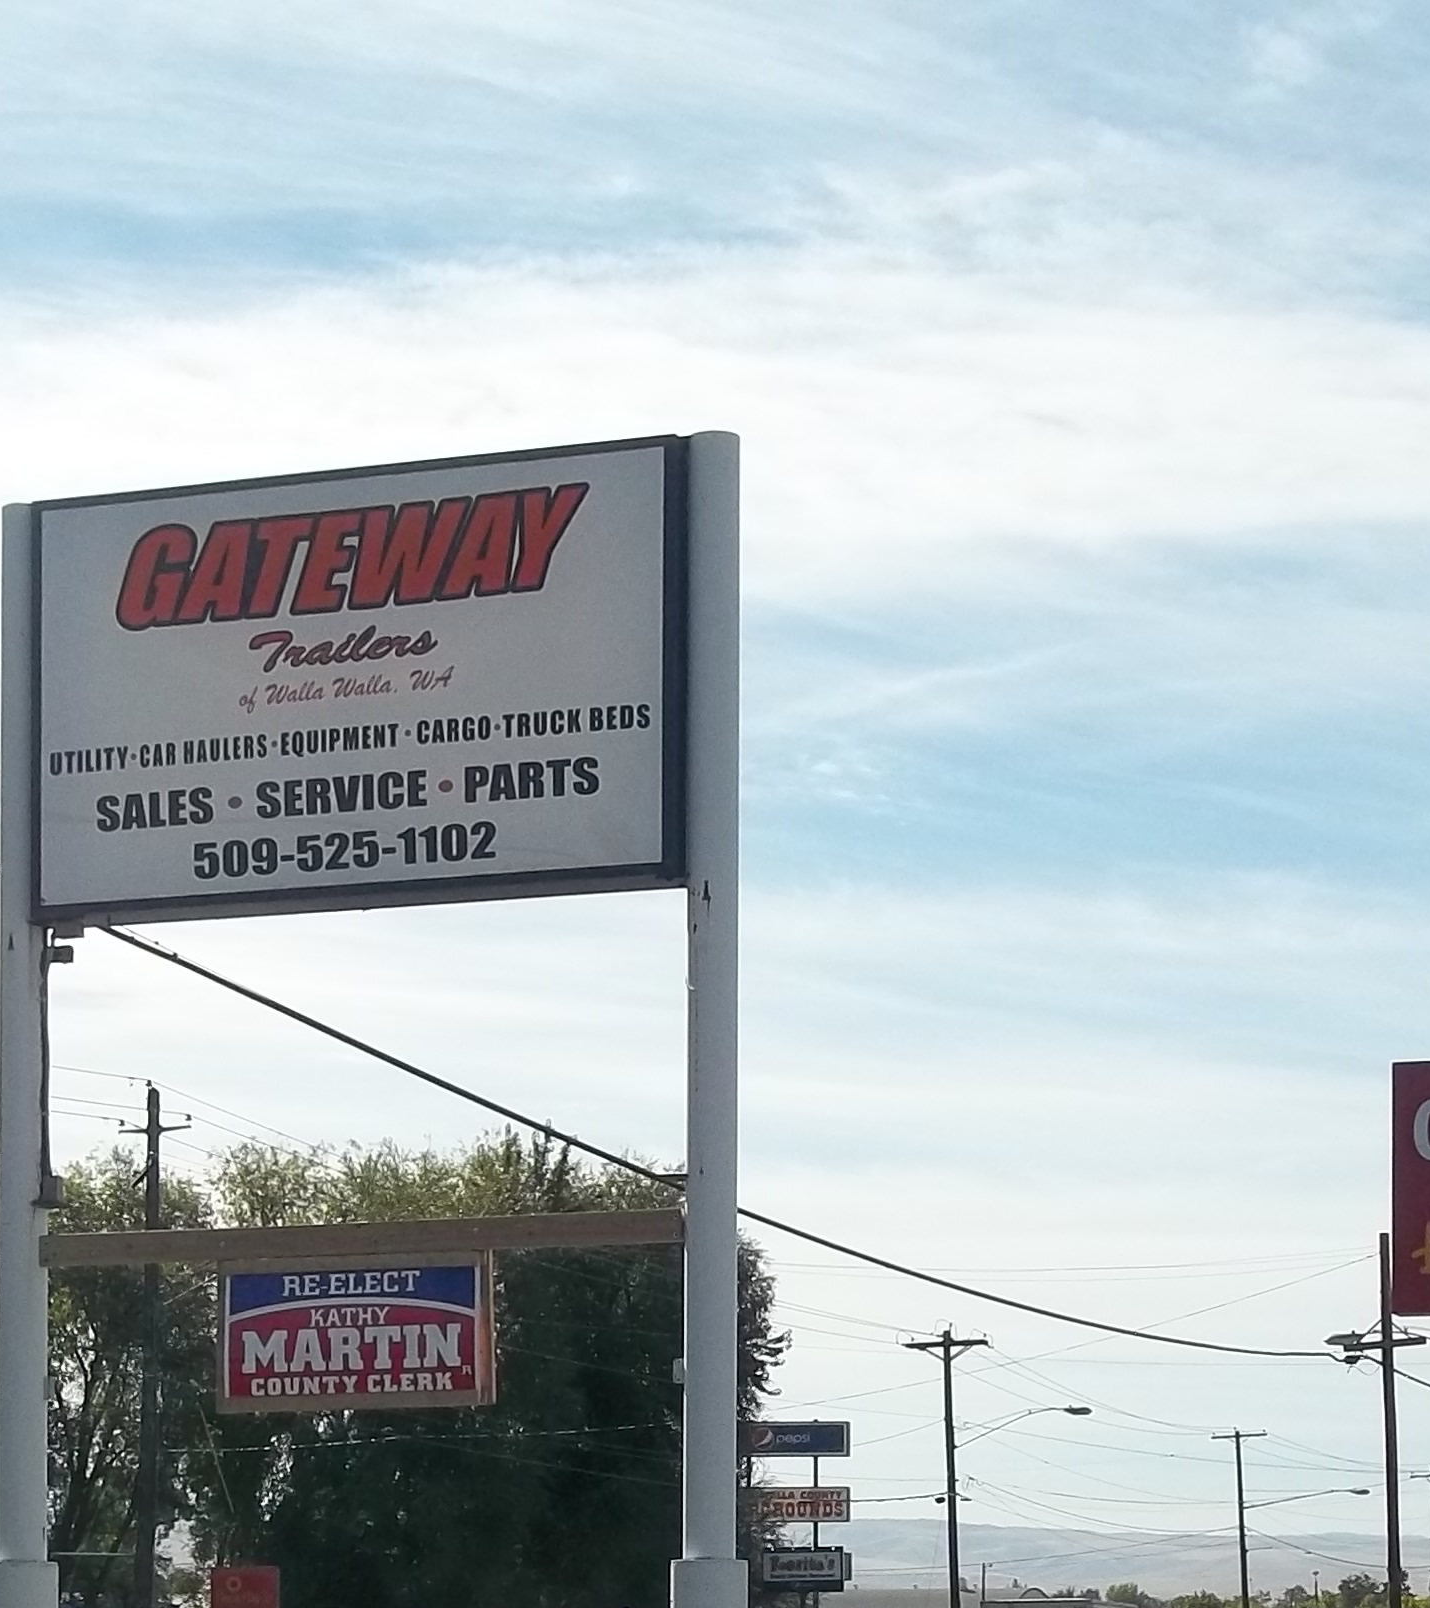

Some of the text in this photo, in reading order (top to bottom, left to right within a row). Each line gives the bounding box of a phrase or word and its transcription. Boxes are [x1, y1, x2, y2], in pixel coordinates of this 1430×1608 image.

[116, 482, 590, 631] GATEWAY
[249, 625, 438, 673] Trailers
[239, 686, 258, 714] of
[265, 682, 324, 705] Walla
[410, 665, 455, 691] WA
[49, 704, 651, 776] UTILITY CAR HAULERS EQUIPMENT CARGO TRUCK BEDS
[96, 756, 600, 832] SALES SERVICE PARTS
[193, 821, 497, 881] 509-525-1102
[282, 1270, 420, 1297] RE-ELECT
[309, 1306, 390, 1328] KATHY
[241, 1323, 462, 1374] MARTIN
[250, 1371, 454, 1397] COUNTY CLERK
[776, 1433, 810, 1444] pepsi
